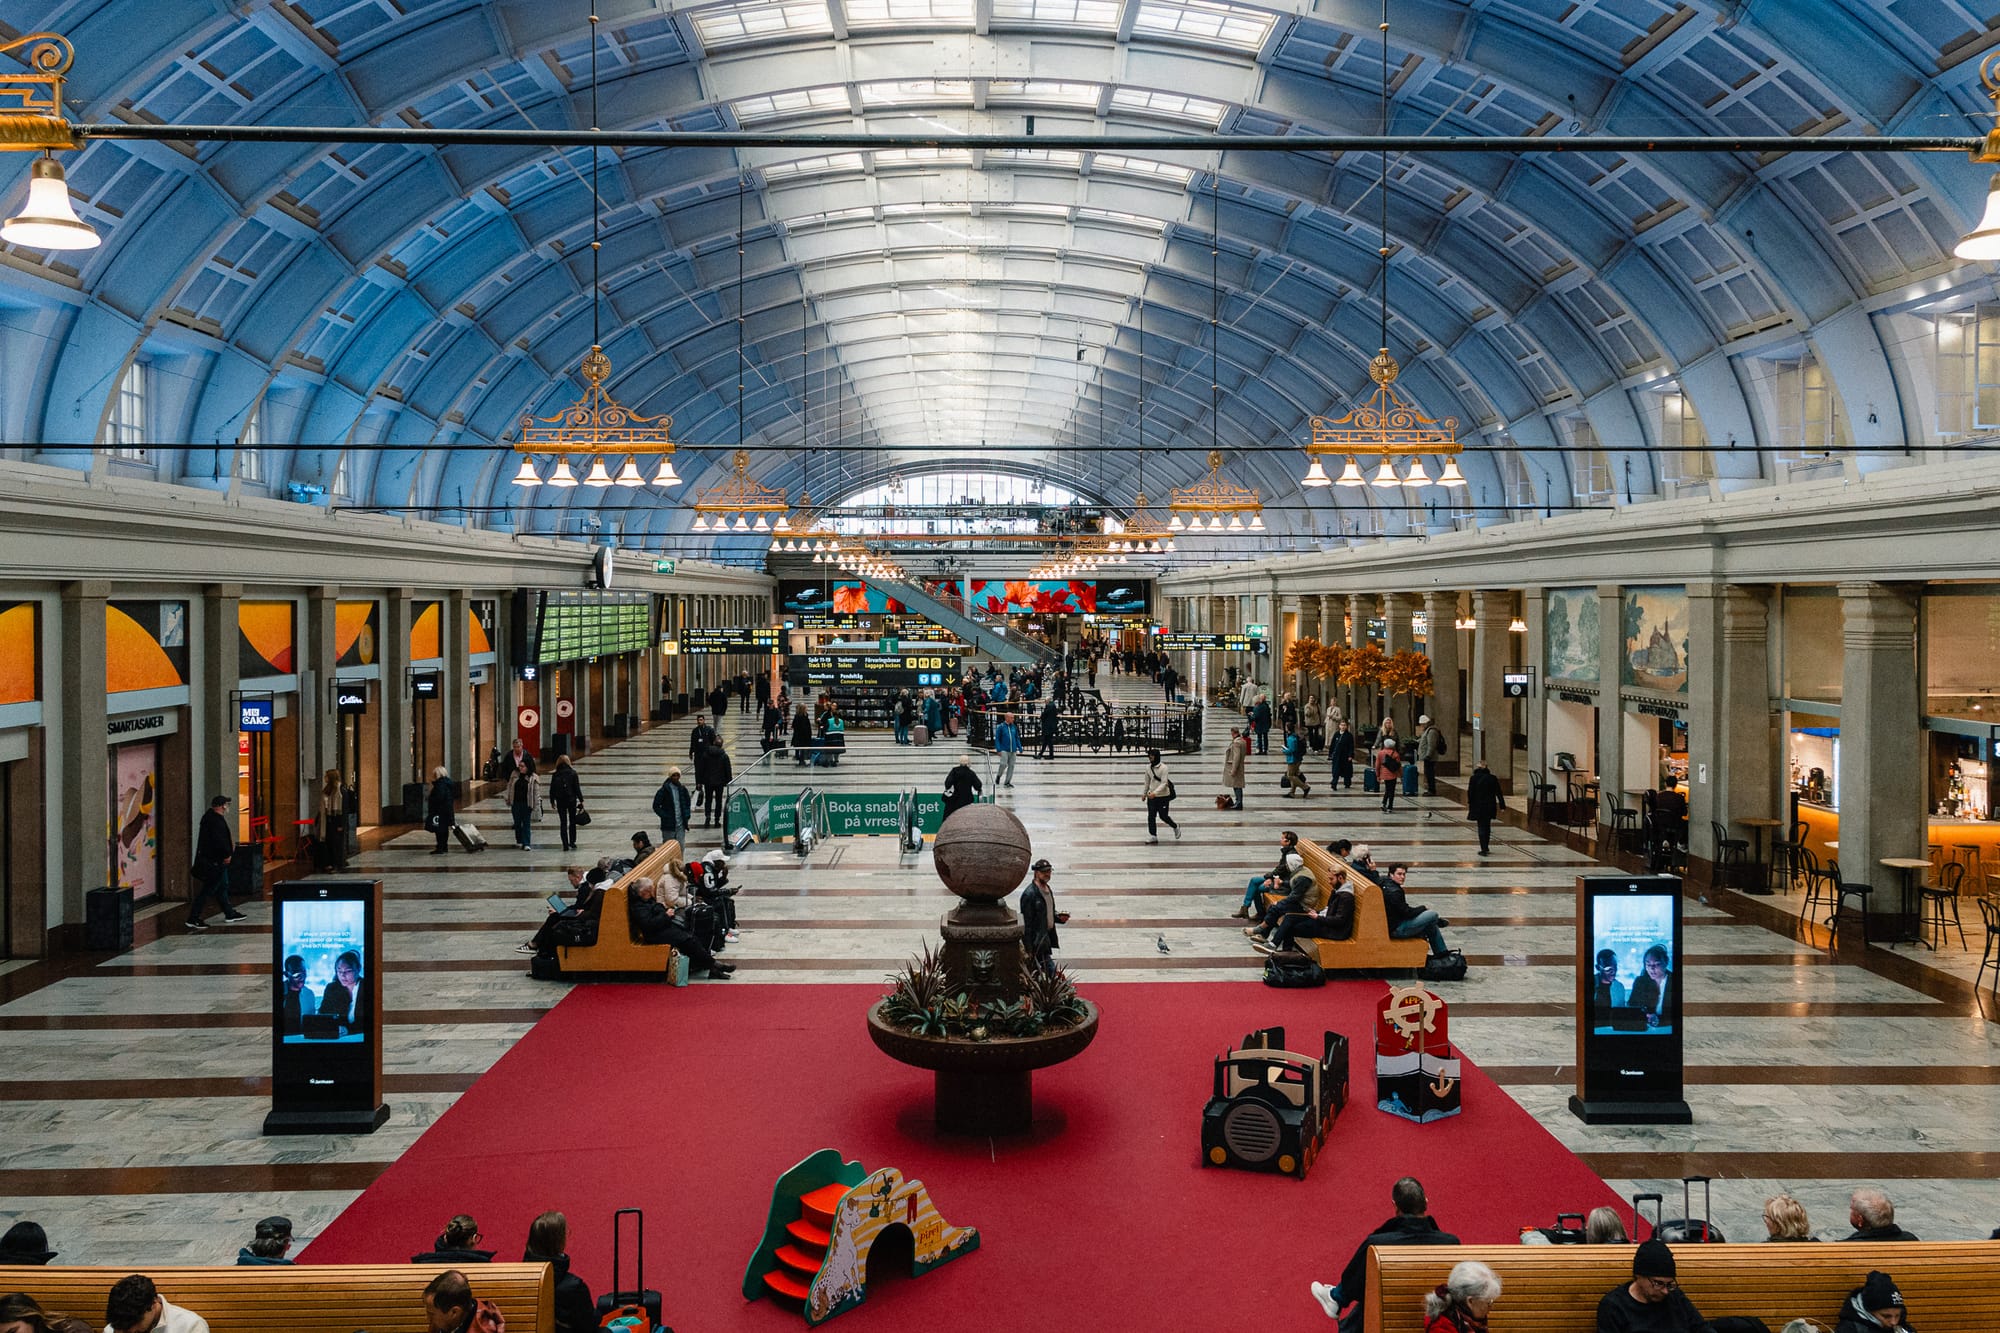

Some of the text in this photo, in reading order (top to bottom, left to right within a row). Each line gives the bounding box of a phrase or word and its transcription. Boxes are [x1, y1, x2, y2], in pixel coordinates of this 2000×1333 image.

[107, 715, 164, 736] SMARTASAKER
[829, 801, 939, 814] Boka snabget
[844, 814, 861, 829] på
